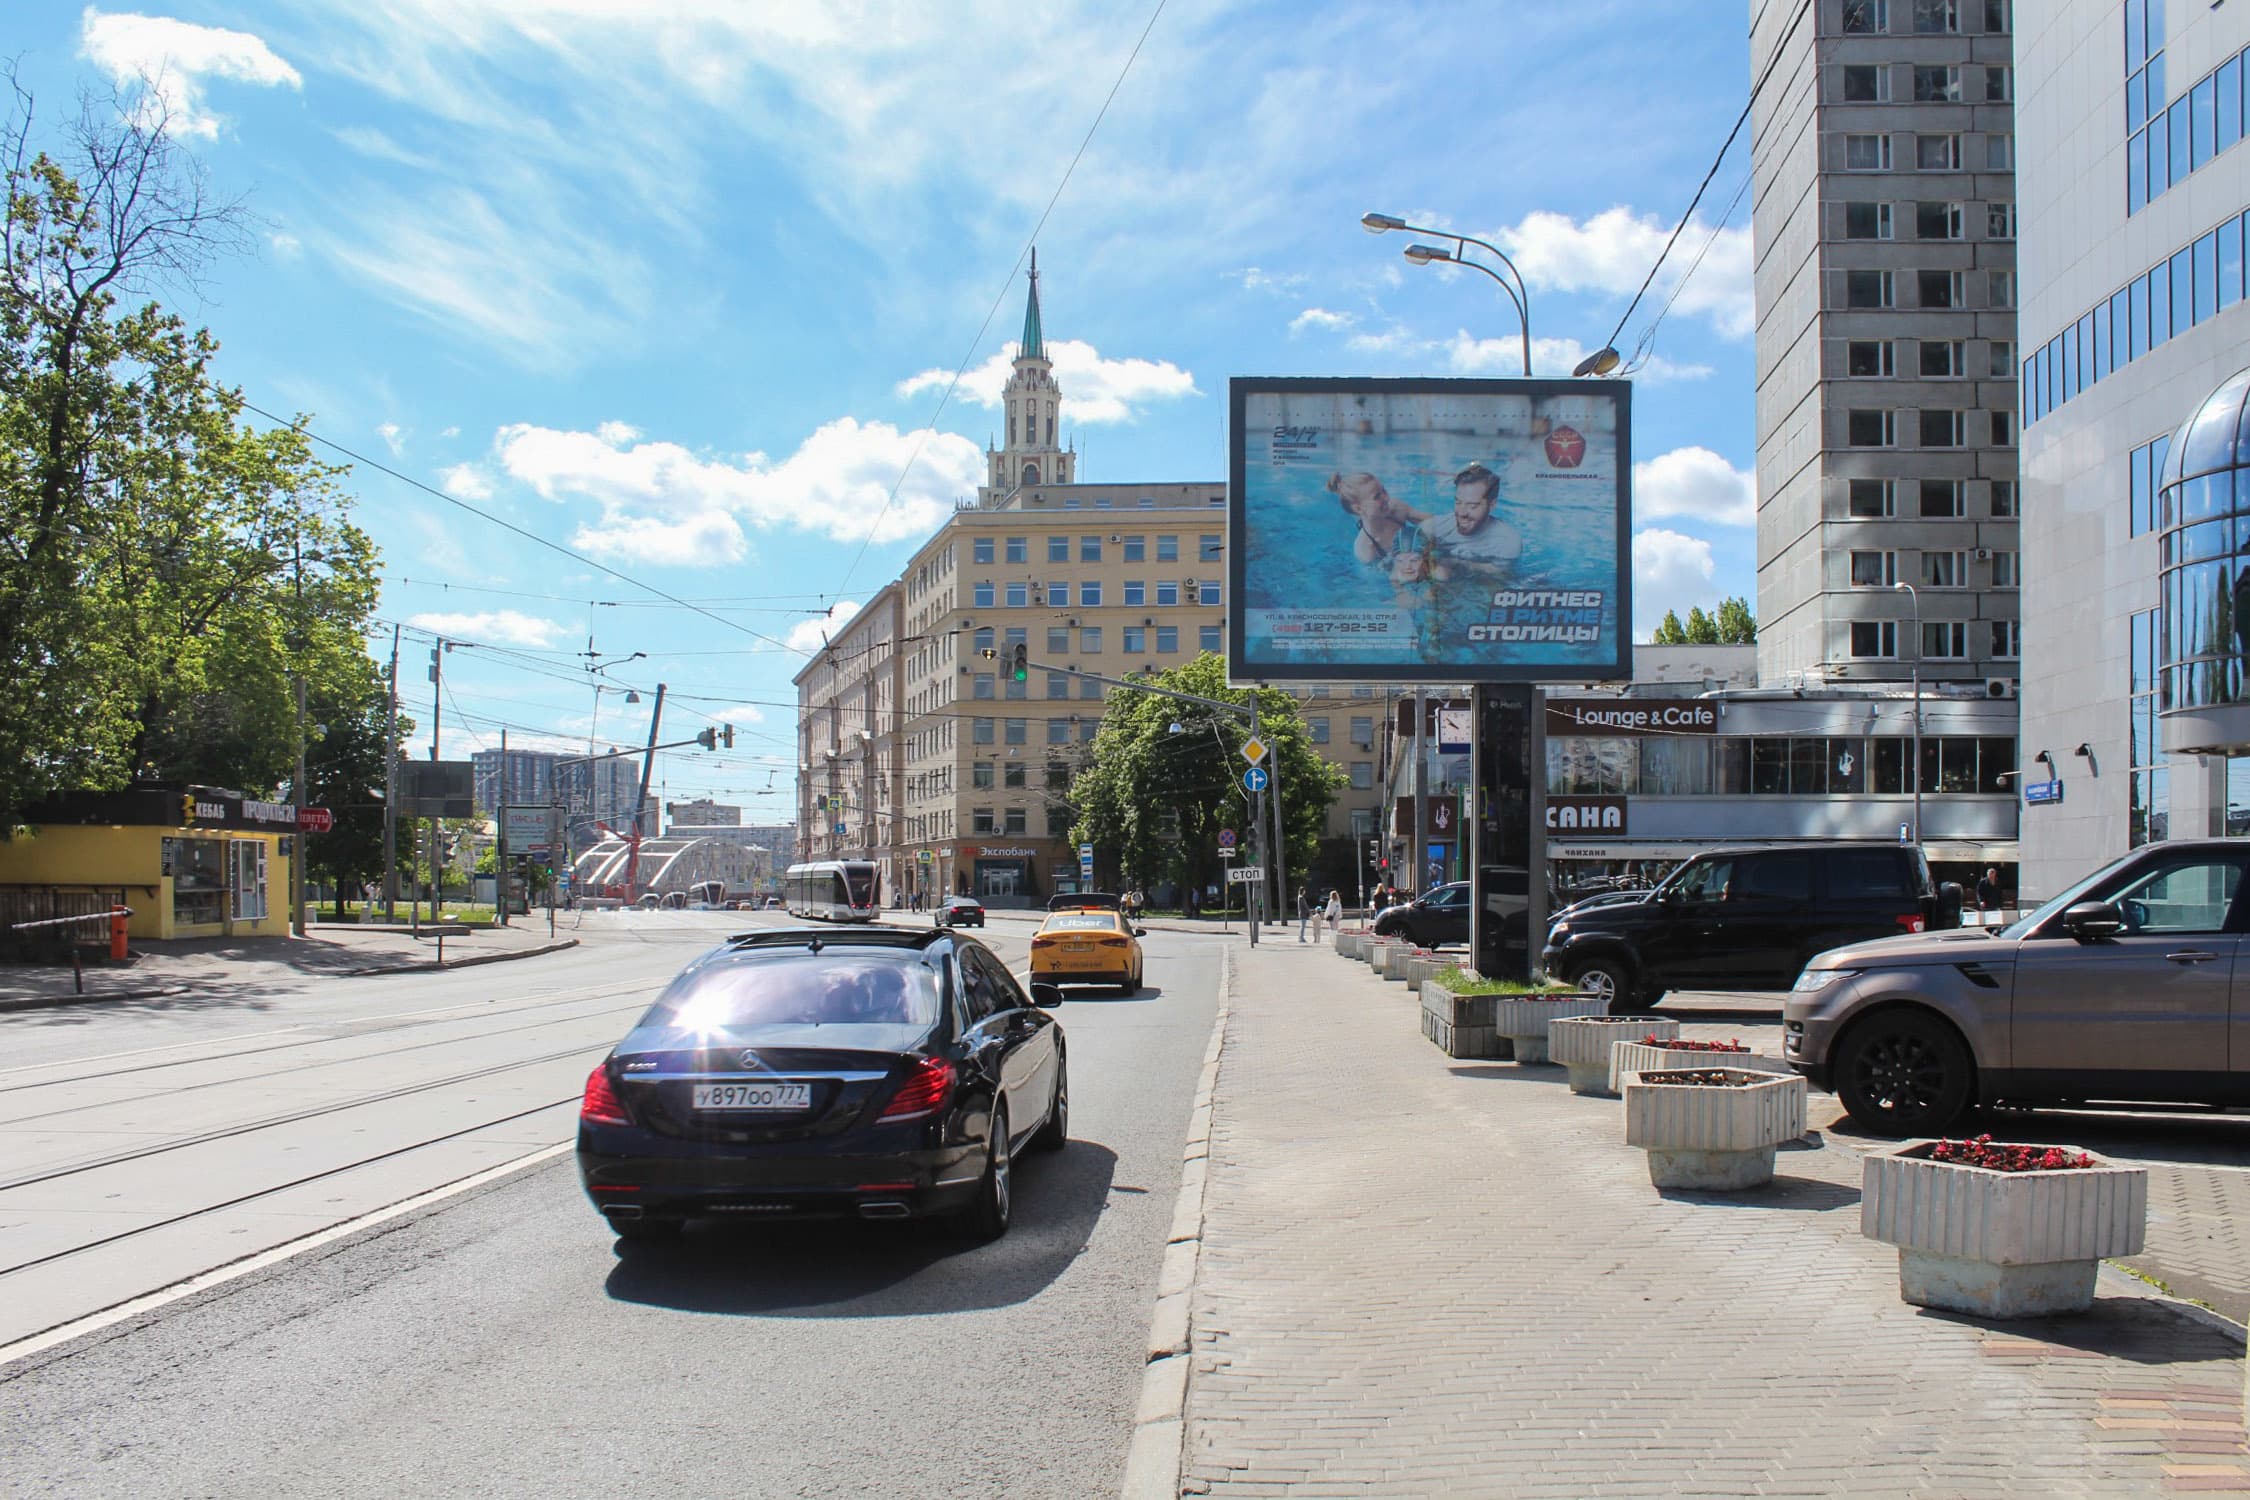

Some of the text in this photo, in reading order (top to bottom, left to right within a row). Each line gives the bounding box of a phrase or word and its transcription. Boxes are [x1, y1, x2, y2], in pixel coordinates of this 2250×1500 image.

[1273, 425, 1318, 441] 24/7
[1493, 591, 1602, 607] ФИТНЕС
[1490, 608, 1601, 623] В РИТМЕ
[1303, 622, 1388, 633] 127-92-52
[1468, 625, 1600, 643] СТОЛИЦЫ
[1575, 707, 1648, 728] Lounge
[1663, 707, 1714, 725] Cafe
[195, 802, 225, 819] КЕБАБ
[980, 846, 1037, 858] Экспобанк
[1232, 870, 1260, 880] СТОП
[1059, 919, 1103, 927] Uber
[777, 1085, 804, 1100] 777
